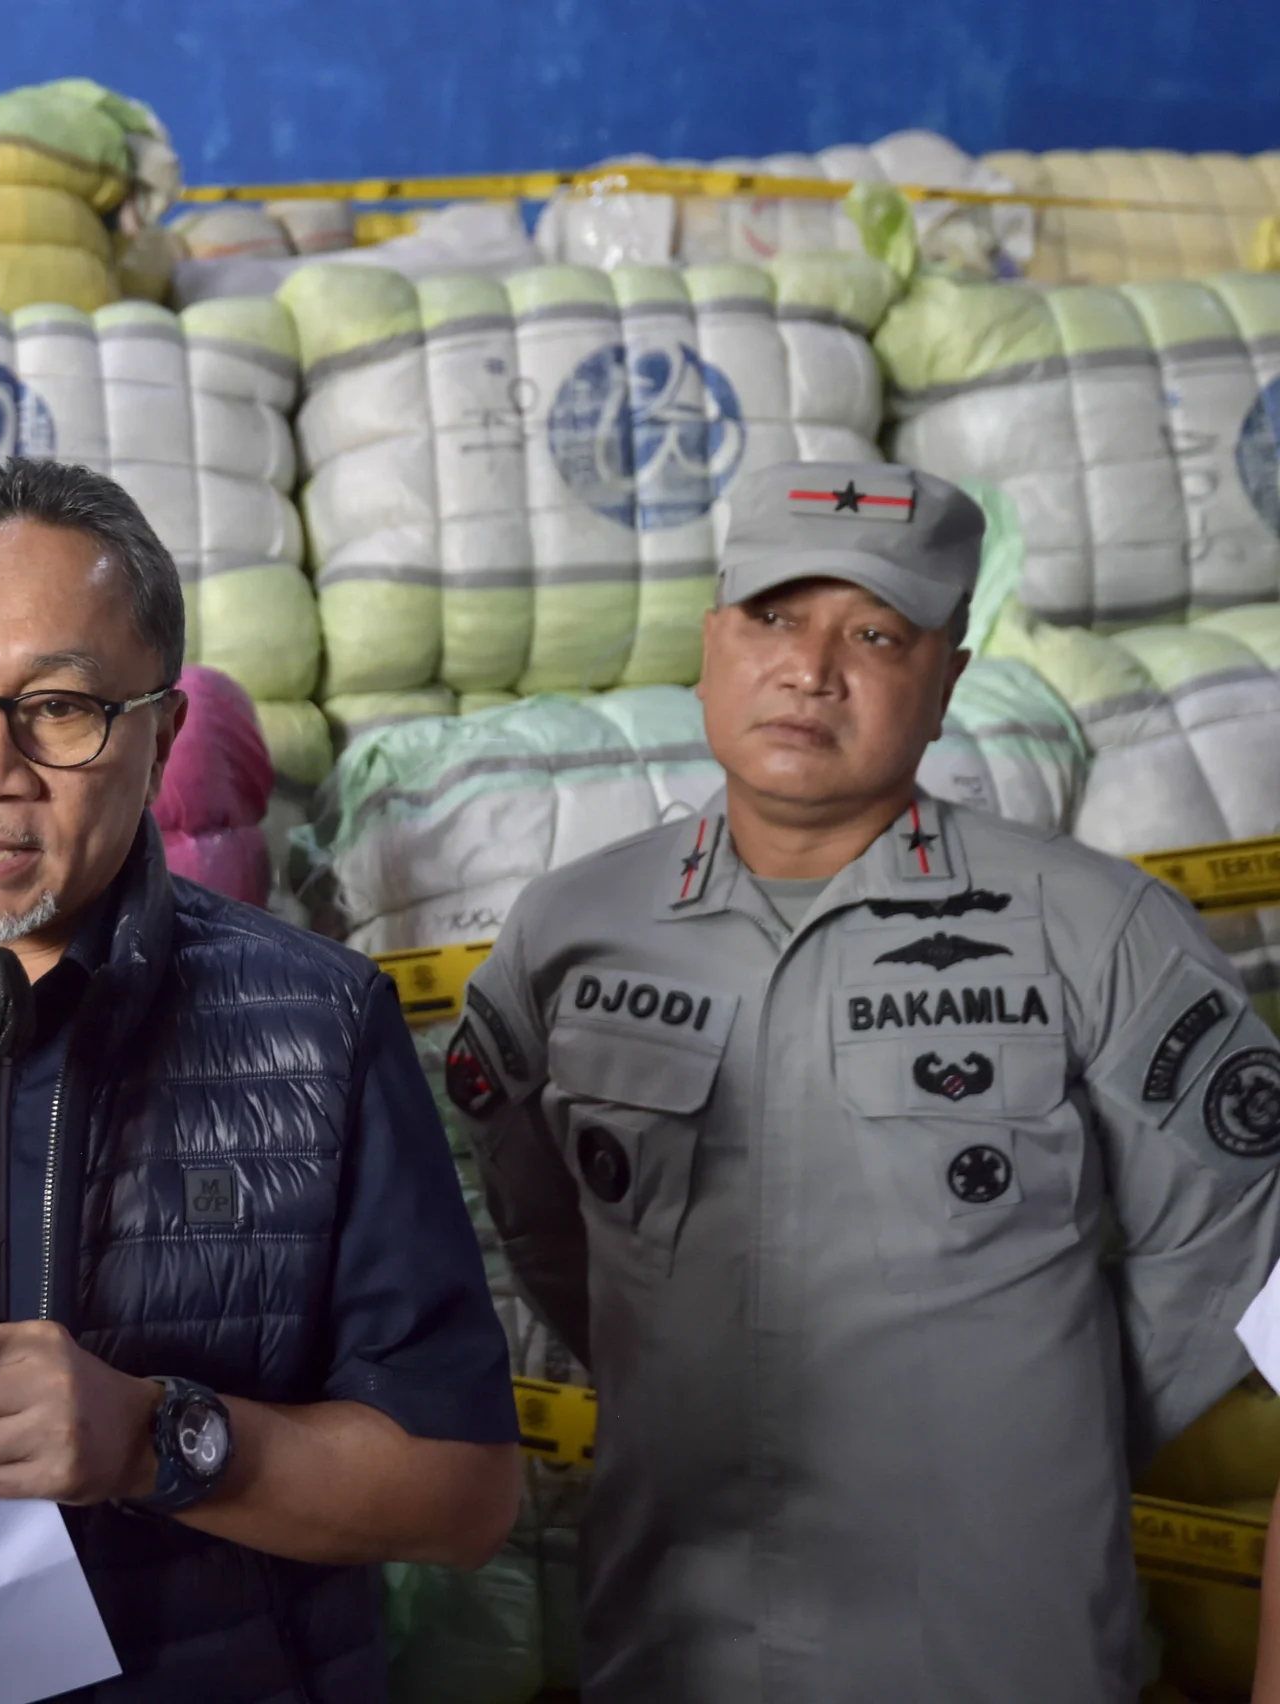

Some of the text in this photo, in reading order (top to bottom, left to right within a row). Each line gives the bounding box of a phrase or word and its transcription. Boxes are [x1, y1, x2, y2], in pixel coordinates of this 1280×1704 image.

[574, 974, 712, 1031] DJODI
[849, 985, 1049, 1031] BAKAMLA
[199, 1178, 221, 1194] M
